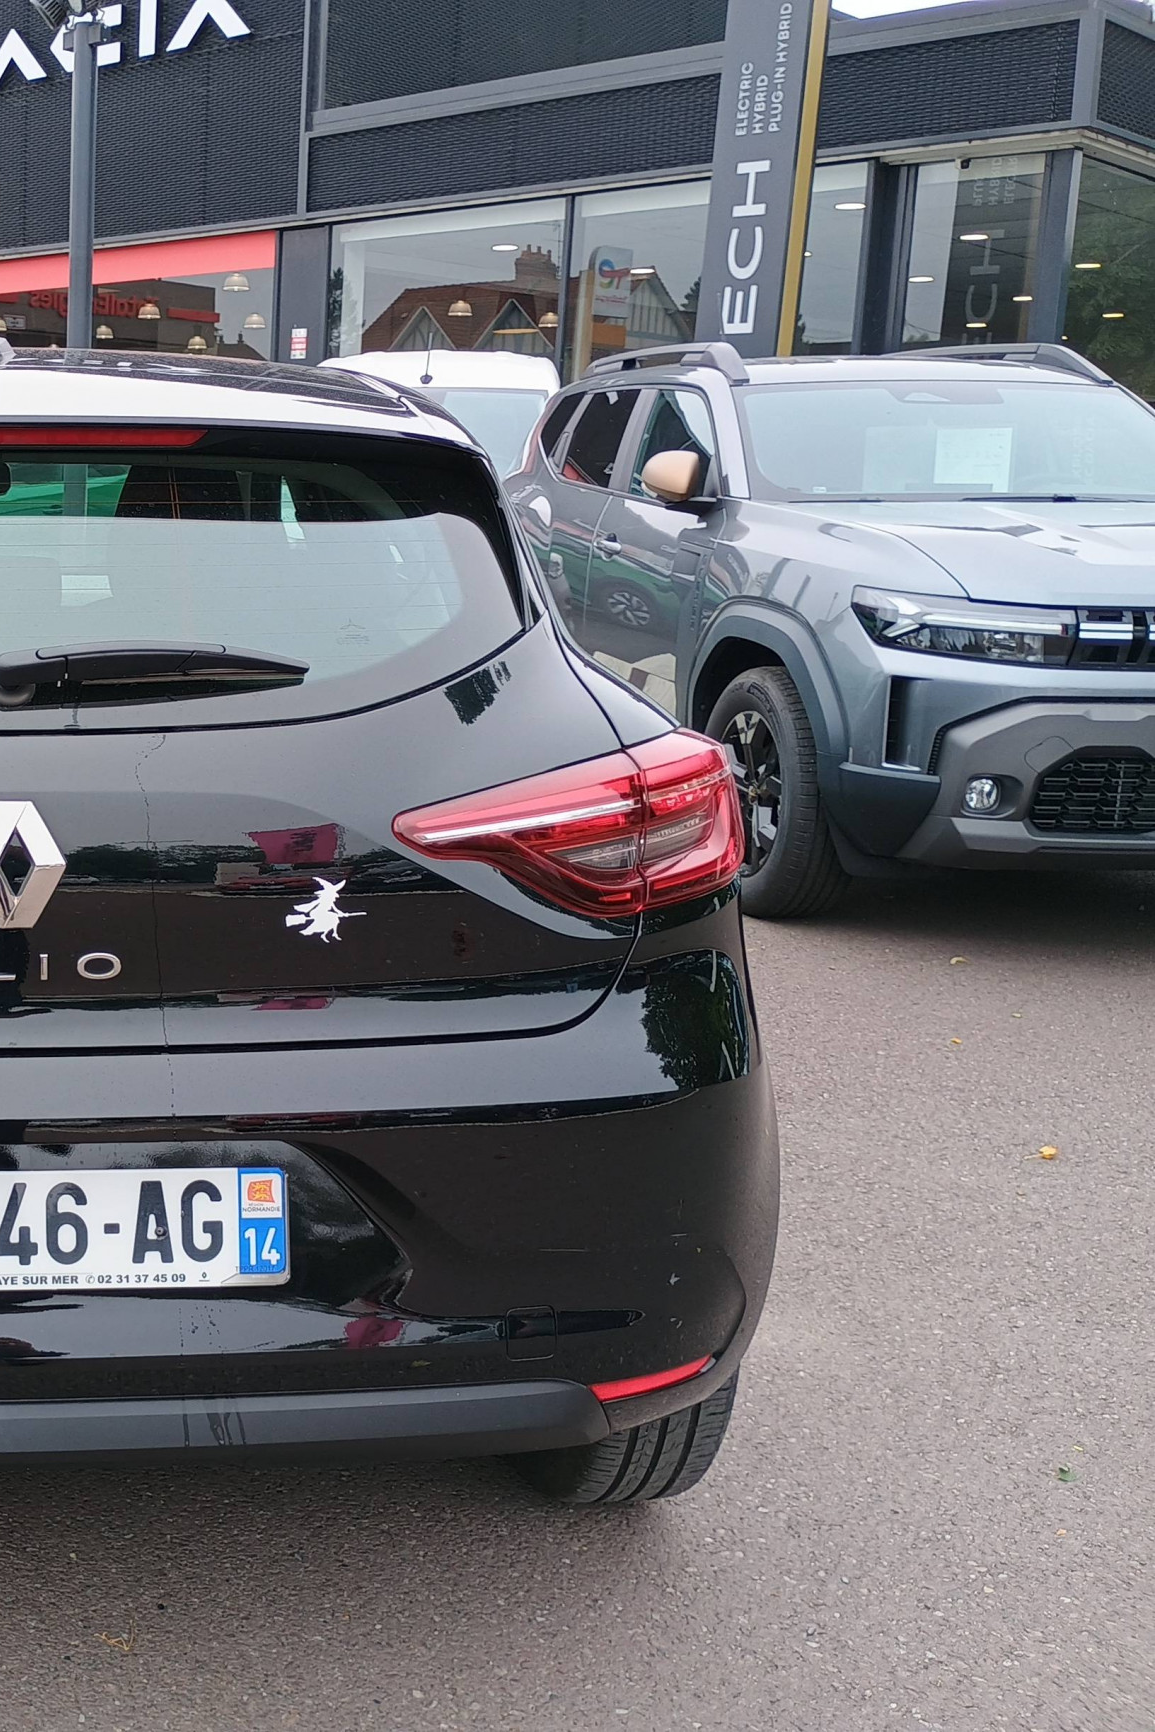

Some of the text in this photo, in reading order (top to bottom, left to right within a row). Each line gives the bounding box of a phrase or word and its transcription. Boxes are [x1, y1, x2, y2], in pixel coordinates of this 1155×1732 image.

[768, 3, 793, 132] PLUG-IN HYBRID
[735, 62, 754, 136] ELECTRIC
[752, 75, 768, 134] HYBRID
[244, 1227, 281, 1266] 14
[22, 1275, 48, 1286] SUR
[52, 1274, 79, 1285] MER
[97, 1274, 113, 1284] 02
[116, 1274, 130, 1284] 31
[134, 1274, 149, 1284] 37
[153, 1273, 168, 1284] 45
[171, 1273, 186, 1283] 09
